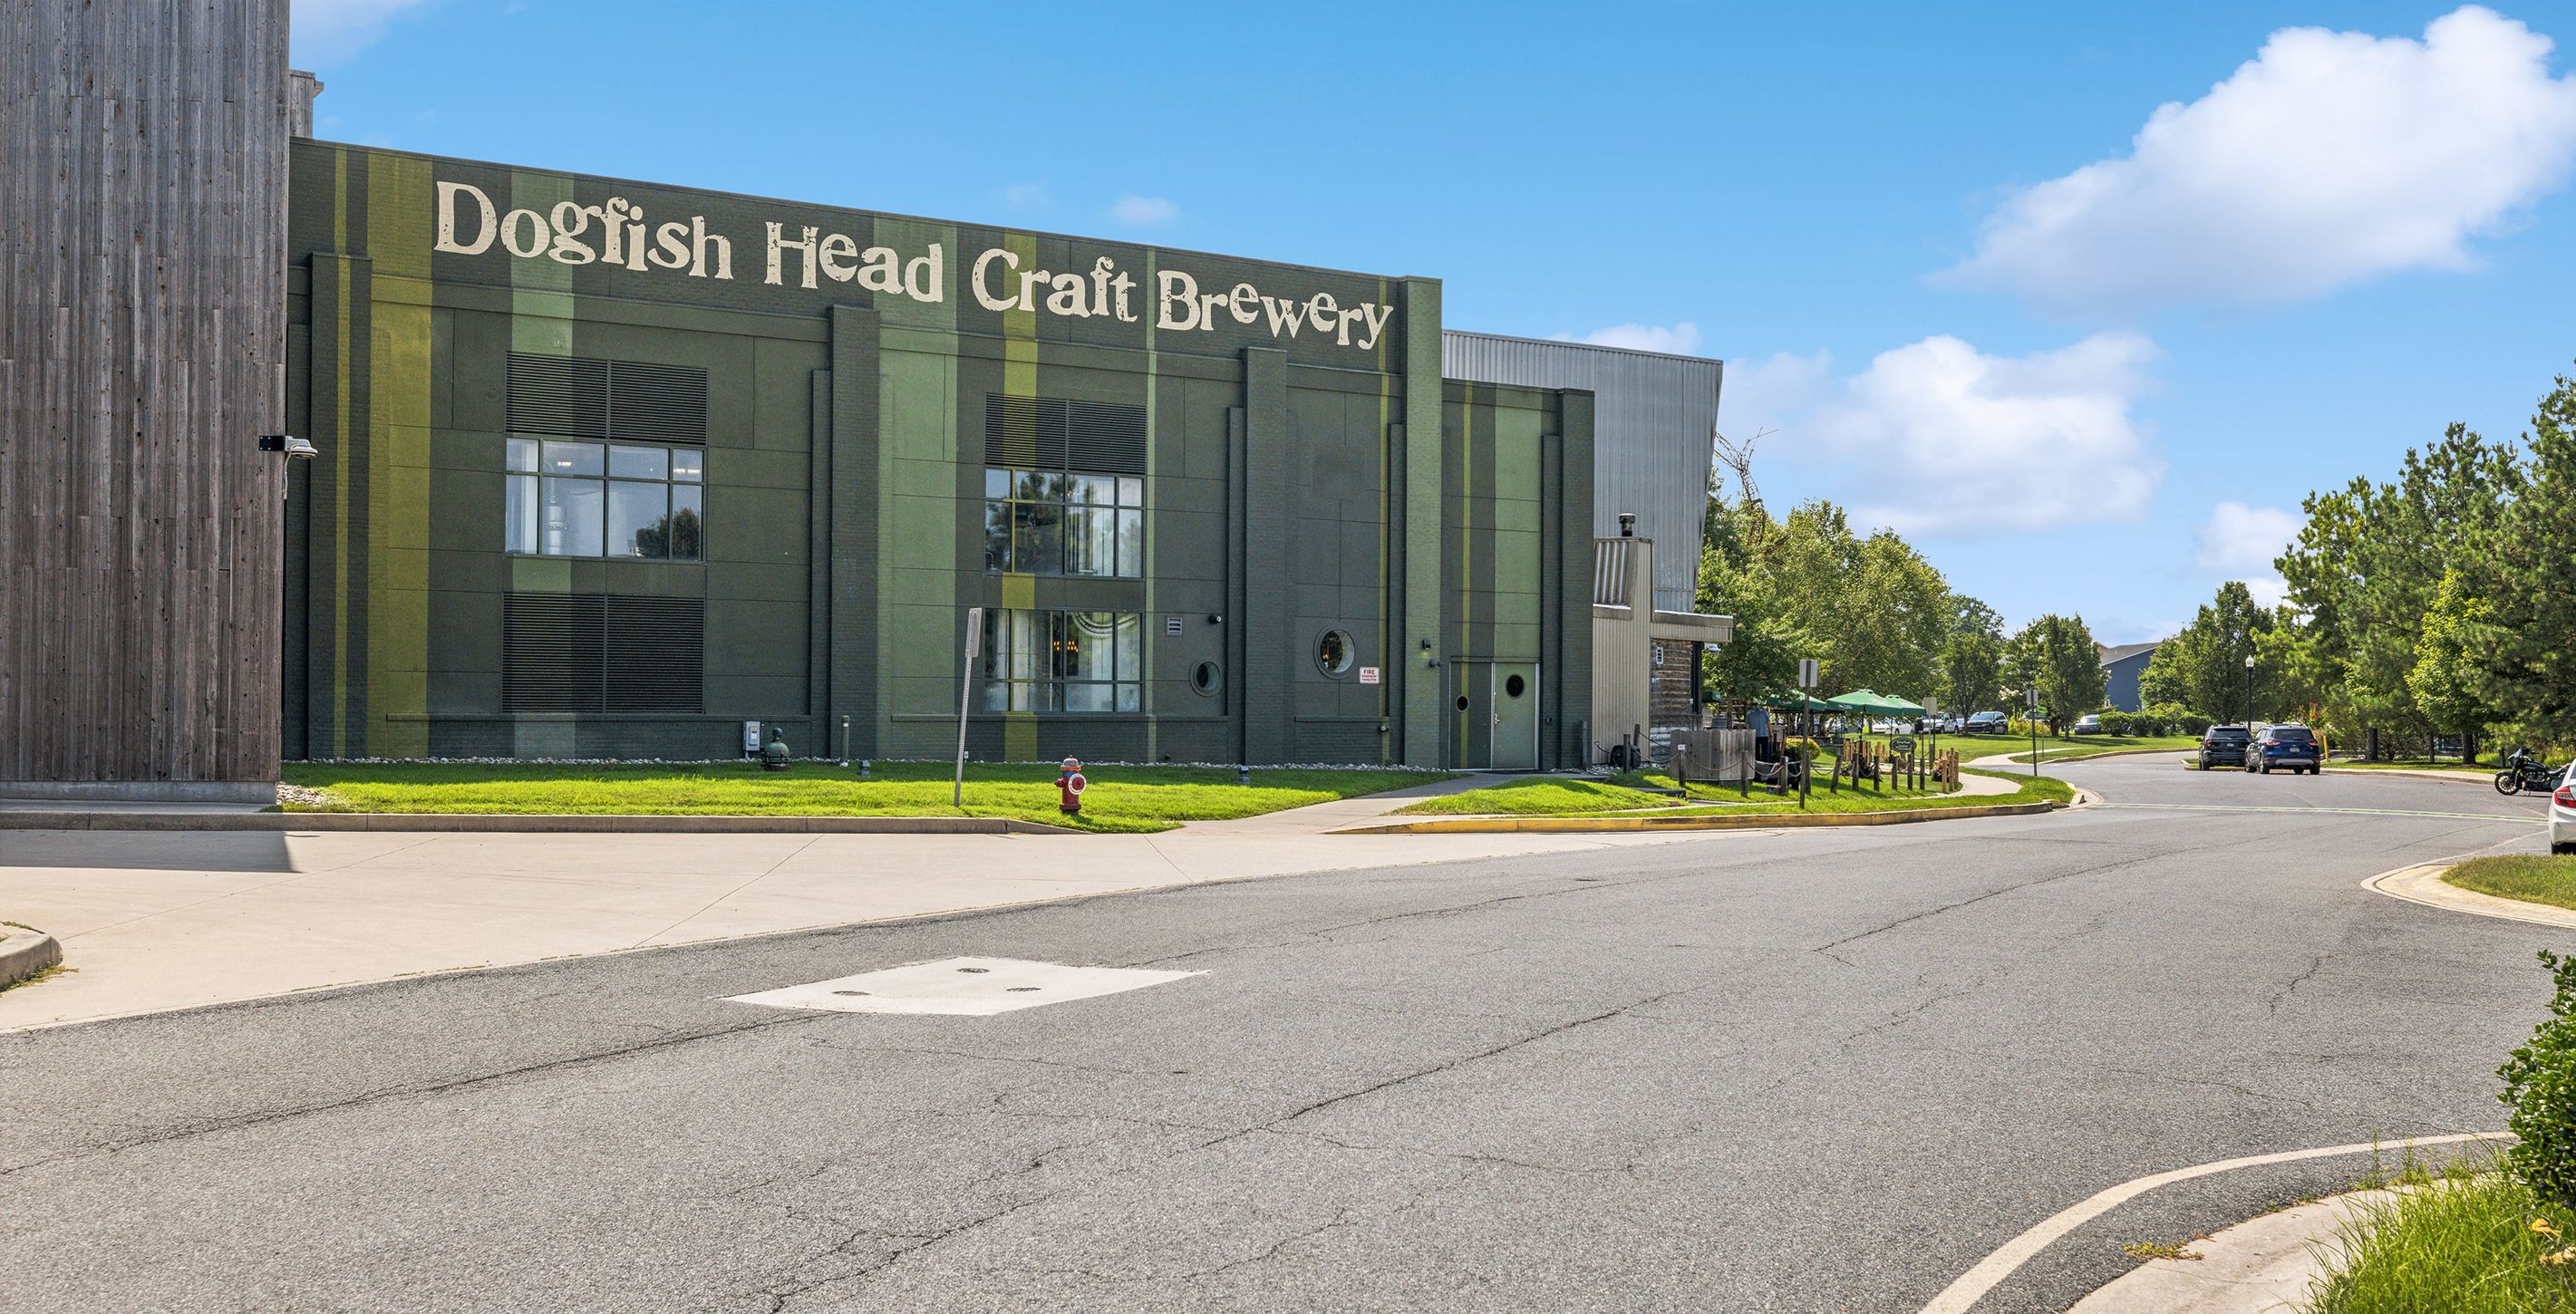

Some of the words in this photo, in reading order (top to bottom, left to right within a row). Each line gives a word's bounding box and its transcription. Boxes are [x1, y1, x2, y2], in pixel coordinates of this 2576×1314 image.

[433, 180, 734, 280] Dogfish
[764, 221, 944, 303] Head
[972, 248, 1138, 323] Craft
[1156, 270, 1394, 350] Brewery
